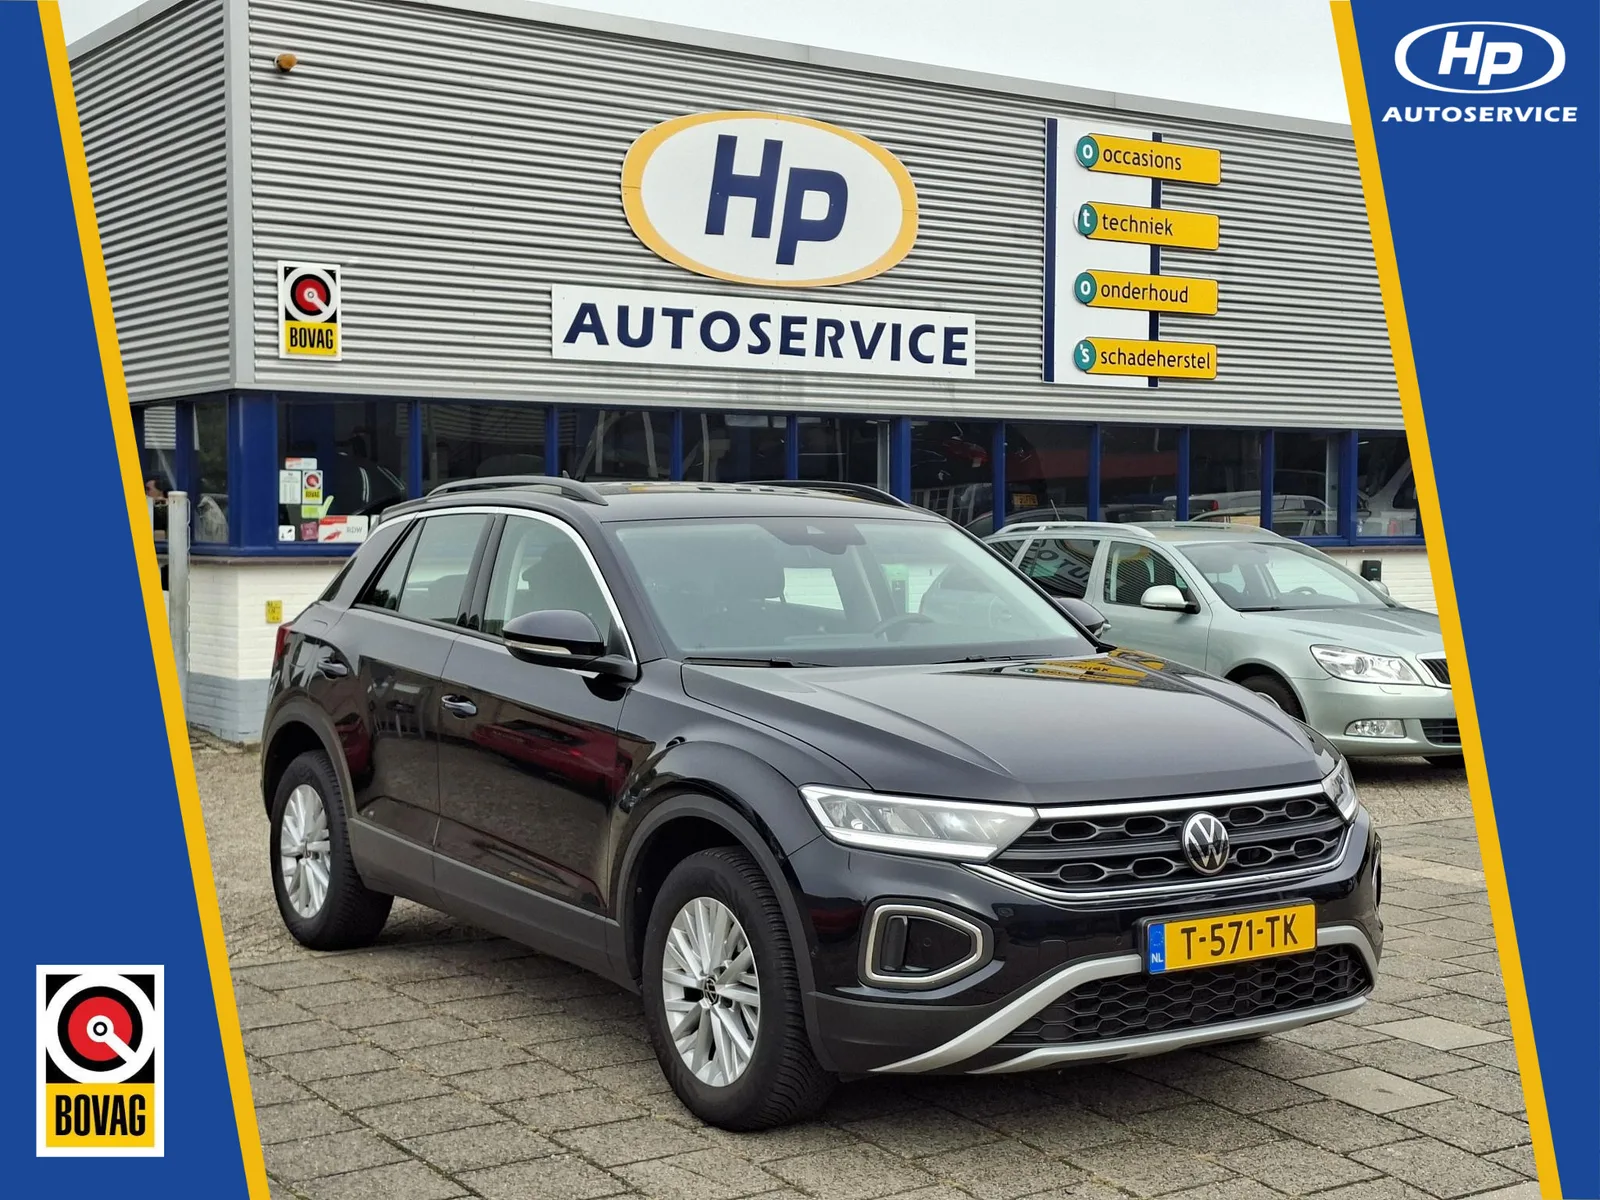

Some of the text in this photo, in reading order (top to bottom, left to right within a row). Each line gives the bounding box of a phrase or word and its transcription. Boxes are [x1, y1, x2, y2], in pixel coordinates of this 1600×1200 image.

[1103, 148, 1182, 171] occasions
[704, 134, 848, 265] Hp
[1102, 213, 1173, 236] techniek
[1101, 281, 1188, 303] onderhoud
[289, 327, 333, 349] BOVAG
[563, 302, 968, 366] AUTOSERVICE
[1101, 347, 1210, 369] schadeherstel
[1151, 913, 1298, 963] NL T-571-TK
